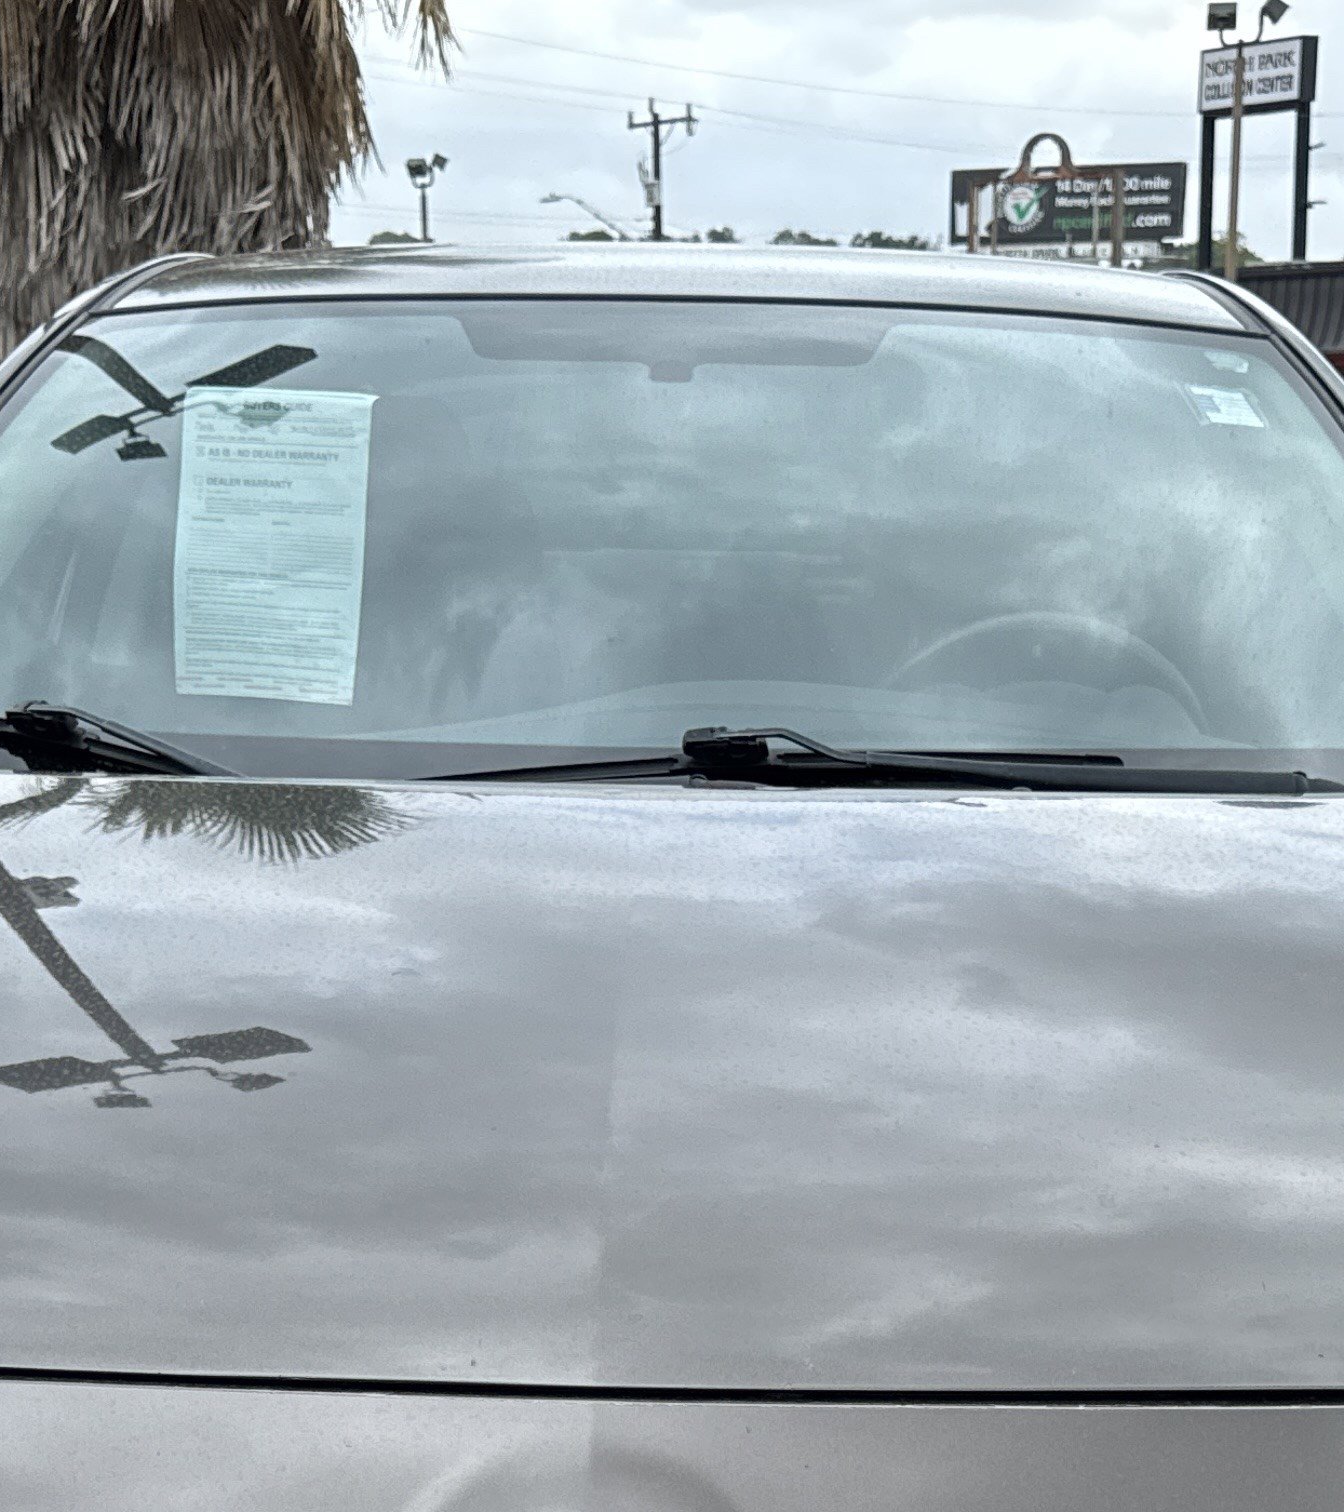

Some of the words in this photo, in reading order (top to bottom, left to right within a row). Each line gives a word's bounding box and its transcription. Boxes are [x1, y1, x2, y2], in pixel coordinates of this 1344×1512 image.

[1205, 55, 1255, 78] NORH
[1258, 50, 1296, 71] PARK
[1257, 73, 1293, 95] CENTER
[237, 449, 251, 458] NO
[252, 449, 287, 459] DEALER
[288, 451, 340, 462] WARRANTY
[206, 477, 241, 487] DEALER
[243, 479, 294, 489] WARRANTY
